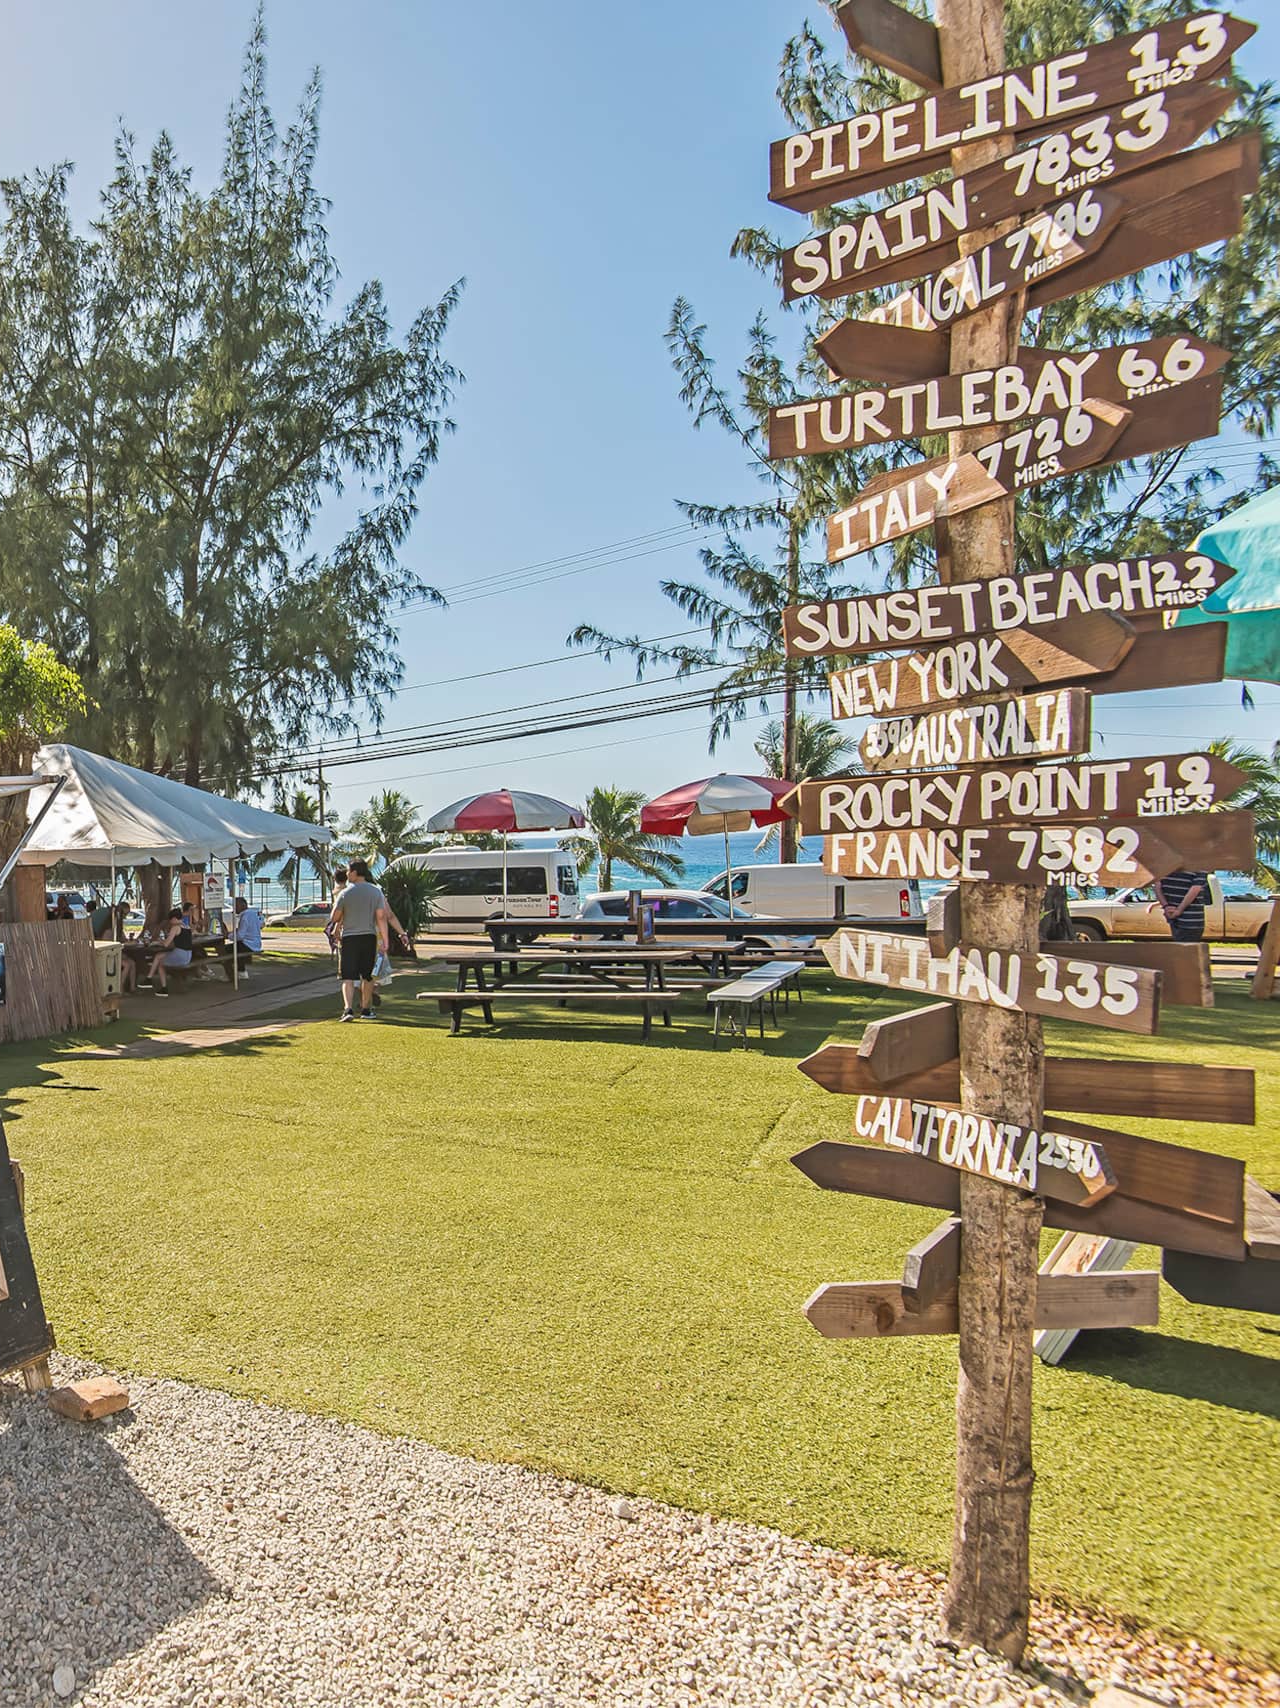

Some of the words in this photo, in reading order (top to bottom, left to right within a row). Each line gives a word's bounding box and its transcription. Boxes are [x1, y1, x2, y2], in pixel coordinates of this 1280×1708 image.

[784, 51, 1098, 188] PIPELINE
[1127, 13, 1227, 81] 1.3
[1135, 65, 1198, 95] Miles
[791, 179, 969, 295] SPAIN
[1005, 92, 1169, 197] 7833
[1056, 158, 1115, 196] Miles
[1006, 189, 1102, 270] 7786
[1024, 252, 1063, 282] Miles
[1117, 338, 1205, 388] 6.6
[833, 462, 958, 558] ITALY
[977, 406, 1093, 479] 7726
[1014, 455, 1060, 488] Miles
[792, 582, 983, 653] SUNSET
[989, 560, 1153, 630] BEACH
[1150, 555, 1216, 590] 2.2
[1154, 587, 1210, 608] Miles
[830, 659, 898, 719] NEW
[908, 638, 1009, 704] YORK
[910, 691, 1070, 766] AUSTRALIA
[820, 774, 971, 832] ROCKY
[981, 761, 1131, 821] POINT
[1137, 795, 1213, 817] Miles
[830, 828, 990, 880] FRANCE
[1009, 826, 1140, 874] 7582
[1046, 870, 1100, 887] Miles
[1035, 957, 1139, 1015] 135
[855, 1095, 1038, 1190] CALIFORNIA
